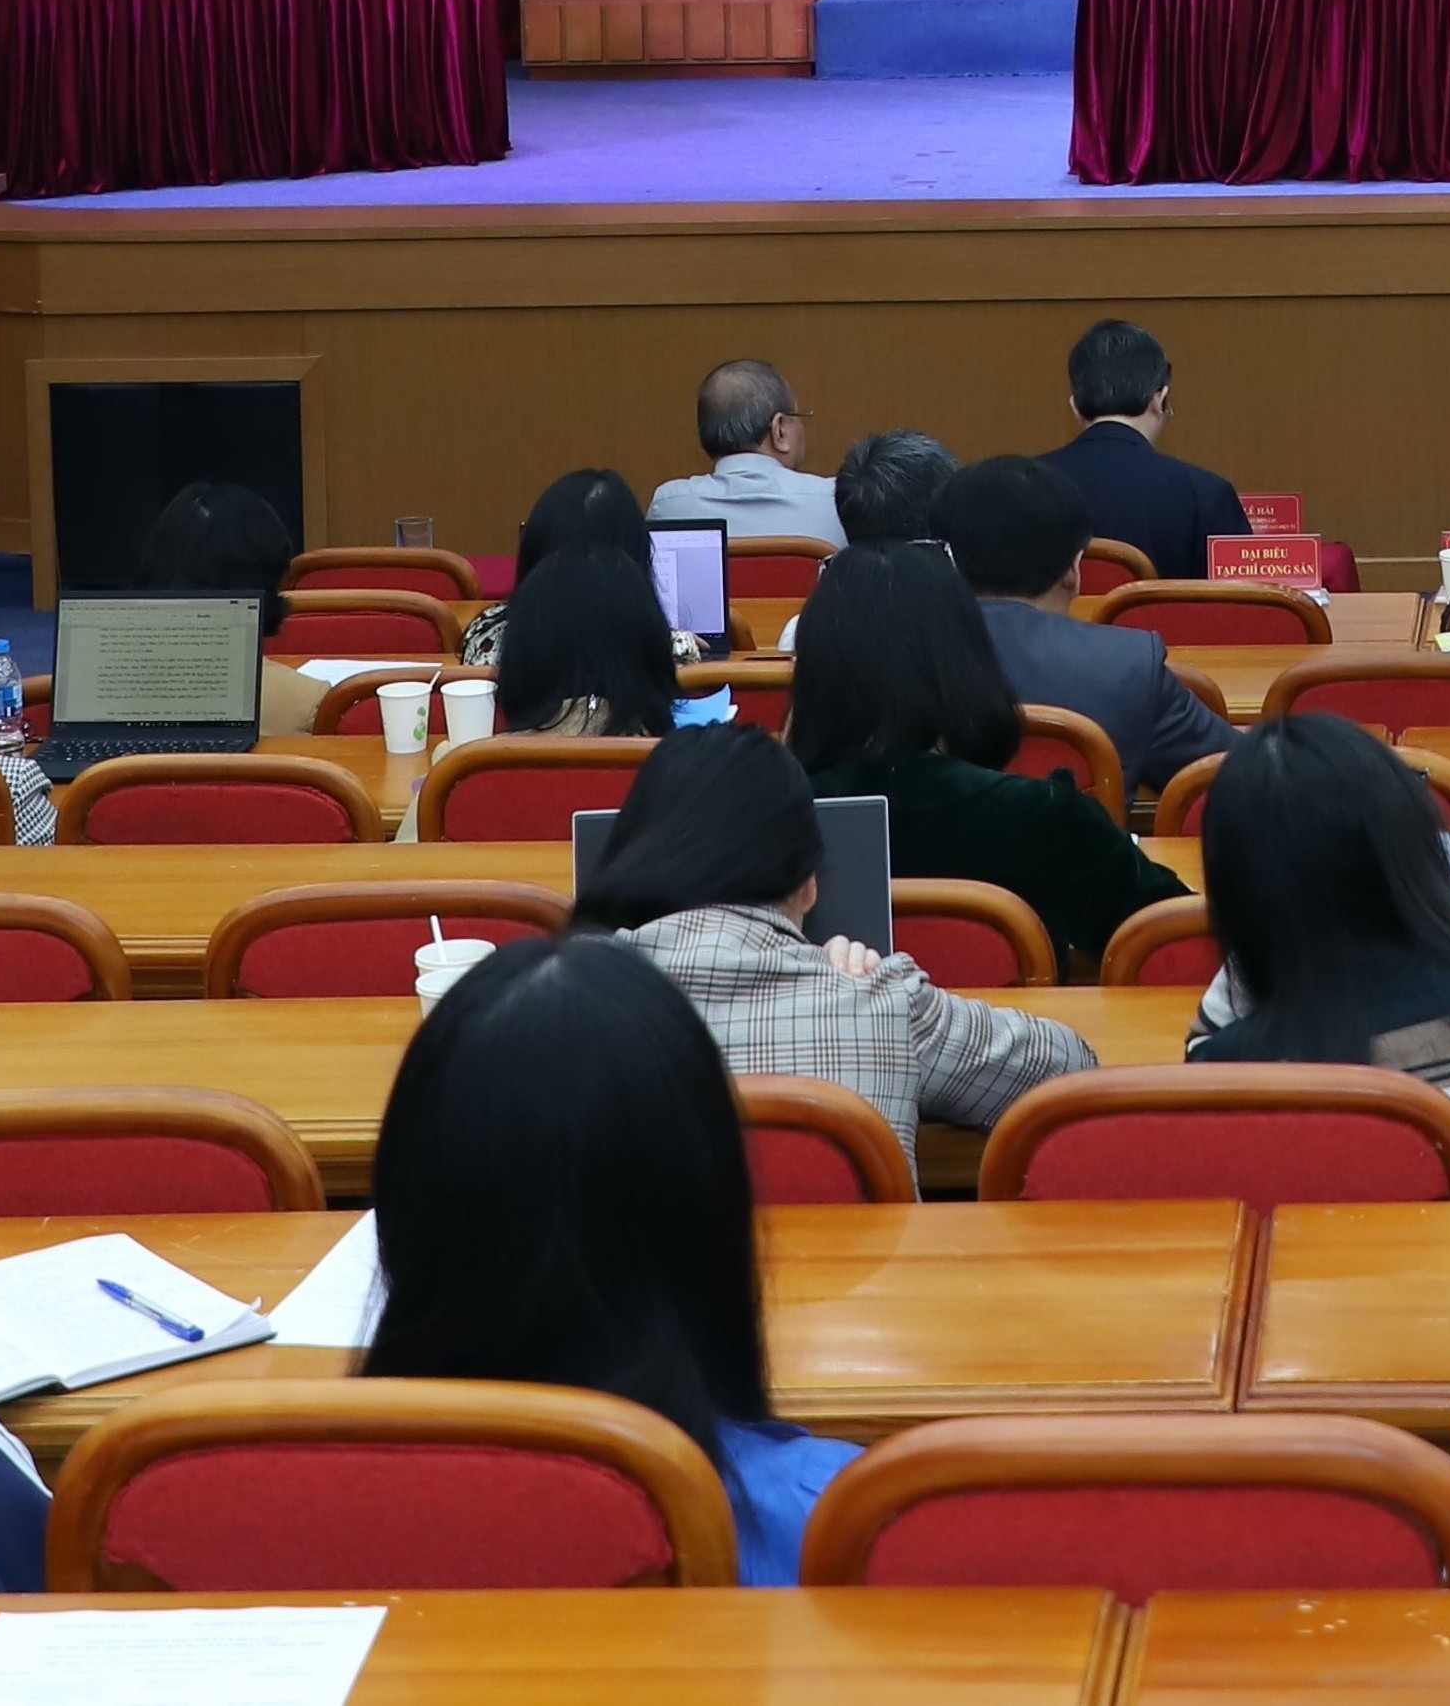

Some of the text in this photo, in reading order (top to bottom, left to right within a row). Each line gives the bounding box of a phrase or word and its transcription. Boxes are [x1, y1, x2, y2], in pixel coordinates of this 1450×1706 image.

[1241, 546, 1288, 561] ĐẠI BIỂU
[1215, 562, 1314, 577] TẠP CHÍ CỘNG SẢN
